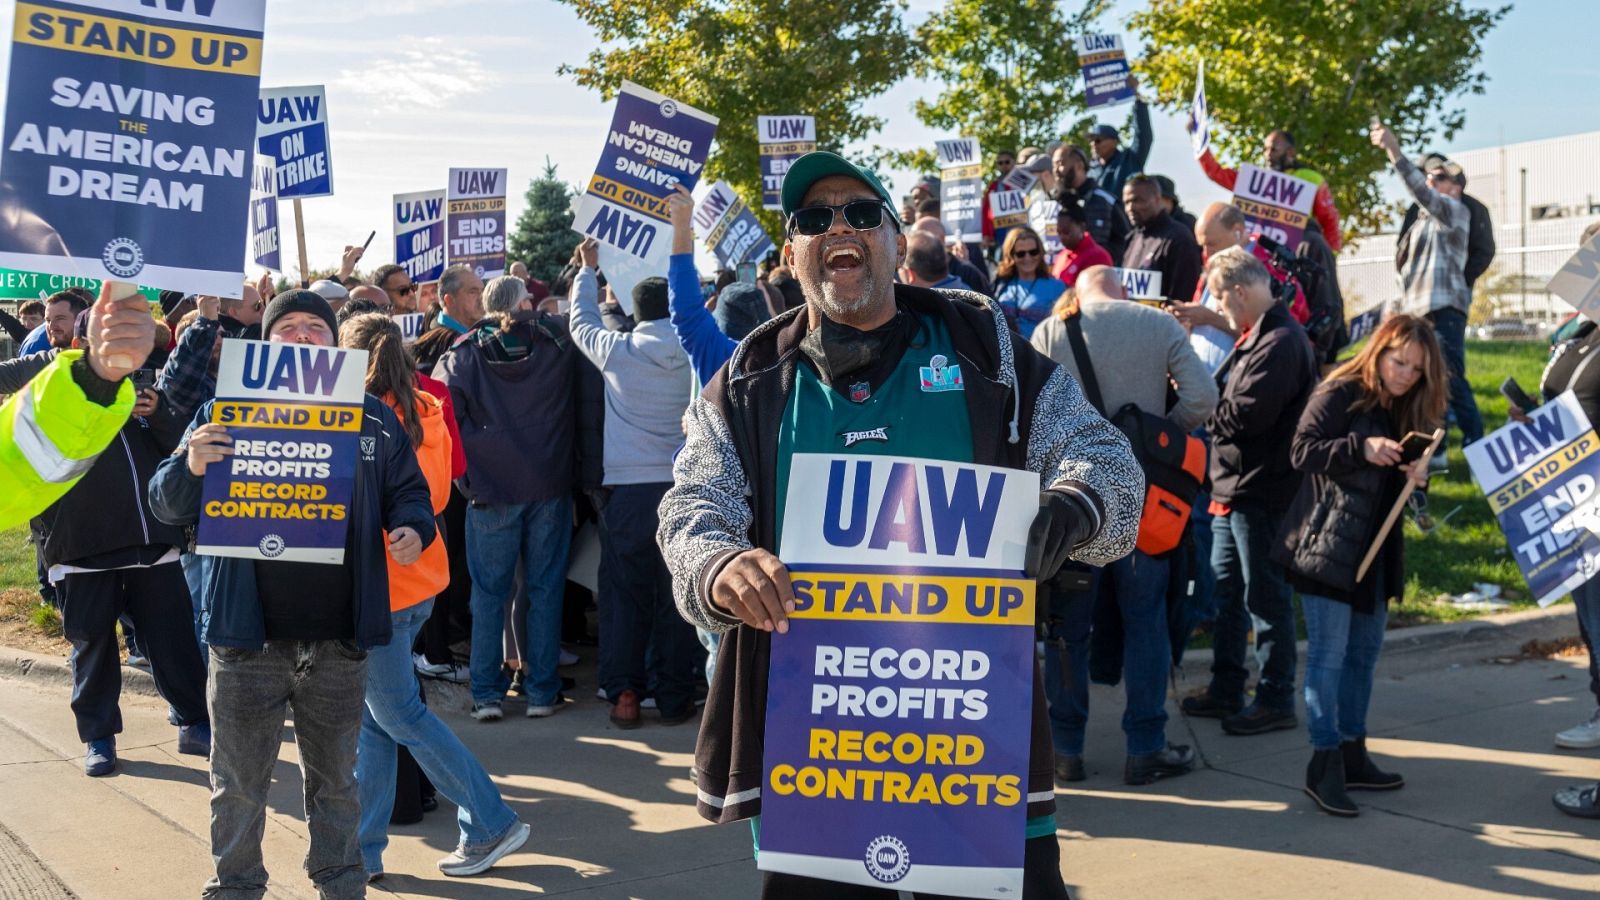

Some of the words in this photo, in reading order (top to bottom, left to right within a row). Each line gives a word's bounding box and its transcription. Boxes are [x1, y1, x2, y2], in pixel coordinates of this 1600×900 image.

[27, 12, 176, 59] STAND
[191, 37, 249, 68] UP
[1084, 34, 1116, 51] UAW
[50, 76, 216, 126] SAVING
[258, 95, 320, 124] UAW
[120, 119, 149, 135] THE
[628, 120, 693, 155] DREAM
[767, 119, 806, 140] UAW
[9, 122, 246, 178] AMERICAN
[280, 131, 306, 162] ON
[608, 130, 703, 176] AMERICAN
[763, 145, 798, 155] STAND
[942, 140, 973, 163] UAW
[276, 151, 326, 191] TRIKE
[615, 156, 680, 191] SAVING
[769, 158, 797, 175] EN
[47, 165, 205, 213] DREAM
[457, 171, 499, 195] UAW
[594, 180, 618, 198] UP
[1249, 169, 1304, 207] UAW
[257, 201, 267, 231] ON
[396, 197, 443, 224] UAW
[451, 202, 487, 212] STAND
[490, 200, 503, 209] UP
[622, 188, 671, 218] TAND
[693, 188, 729, 230] UAW
[1235, 200, 1280, 219] STAND
[1284, 211, 1303, 224] UP
[412, 228, 430, 256] ON
[458, 217, 498, 237] END
[585, 204, 657, 259] UAW
[721, 219, 748, 257] END
[254, 226, 278, 261] STRIKE
[450, 235, 504, 256] TIERS
[1126, 271, 1152, 297] AW
[403, 314, 424, 338] UA
[242, 342, 347, 396] UAW
[219, 405, 310, 426] STAND
[319, 410, 355, 428] UP
[234, 439, 333, 460] RECORD
[842, 426, 889, 447] EAGLES
[1484, 405, 1566, 475] UAW
[231, 458, 331, 479] PROFITS
[1496, 460, 1560, 507] STAND
[1564, 439, 1592, 461] UP
[229, 481, 328, 500] RECORD
[1519, 473, 1597, 535] END
[205, 500, 347, 521] CONTRACTS
[822, 458, 1008, 560] UAW
[791, 579, 949, 616] STAND
[964, 584, 1025, 618] UP
[814, 644, 991, 681] RECORD
[810, 683, 990, 721] PROFITS
[808, 727, 986, 766] RECORD
[769, 763, 1022, 807] CONTRACTS
[878, 852, 897, 864] UAW
